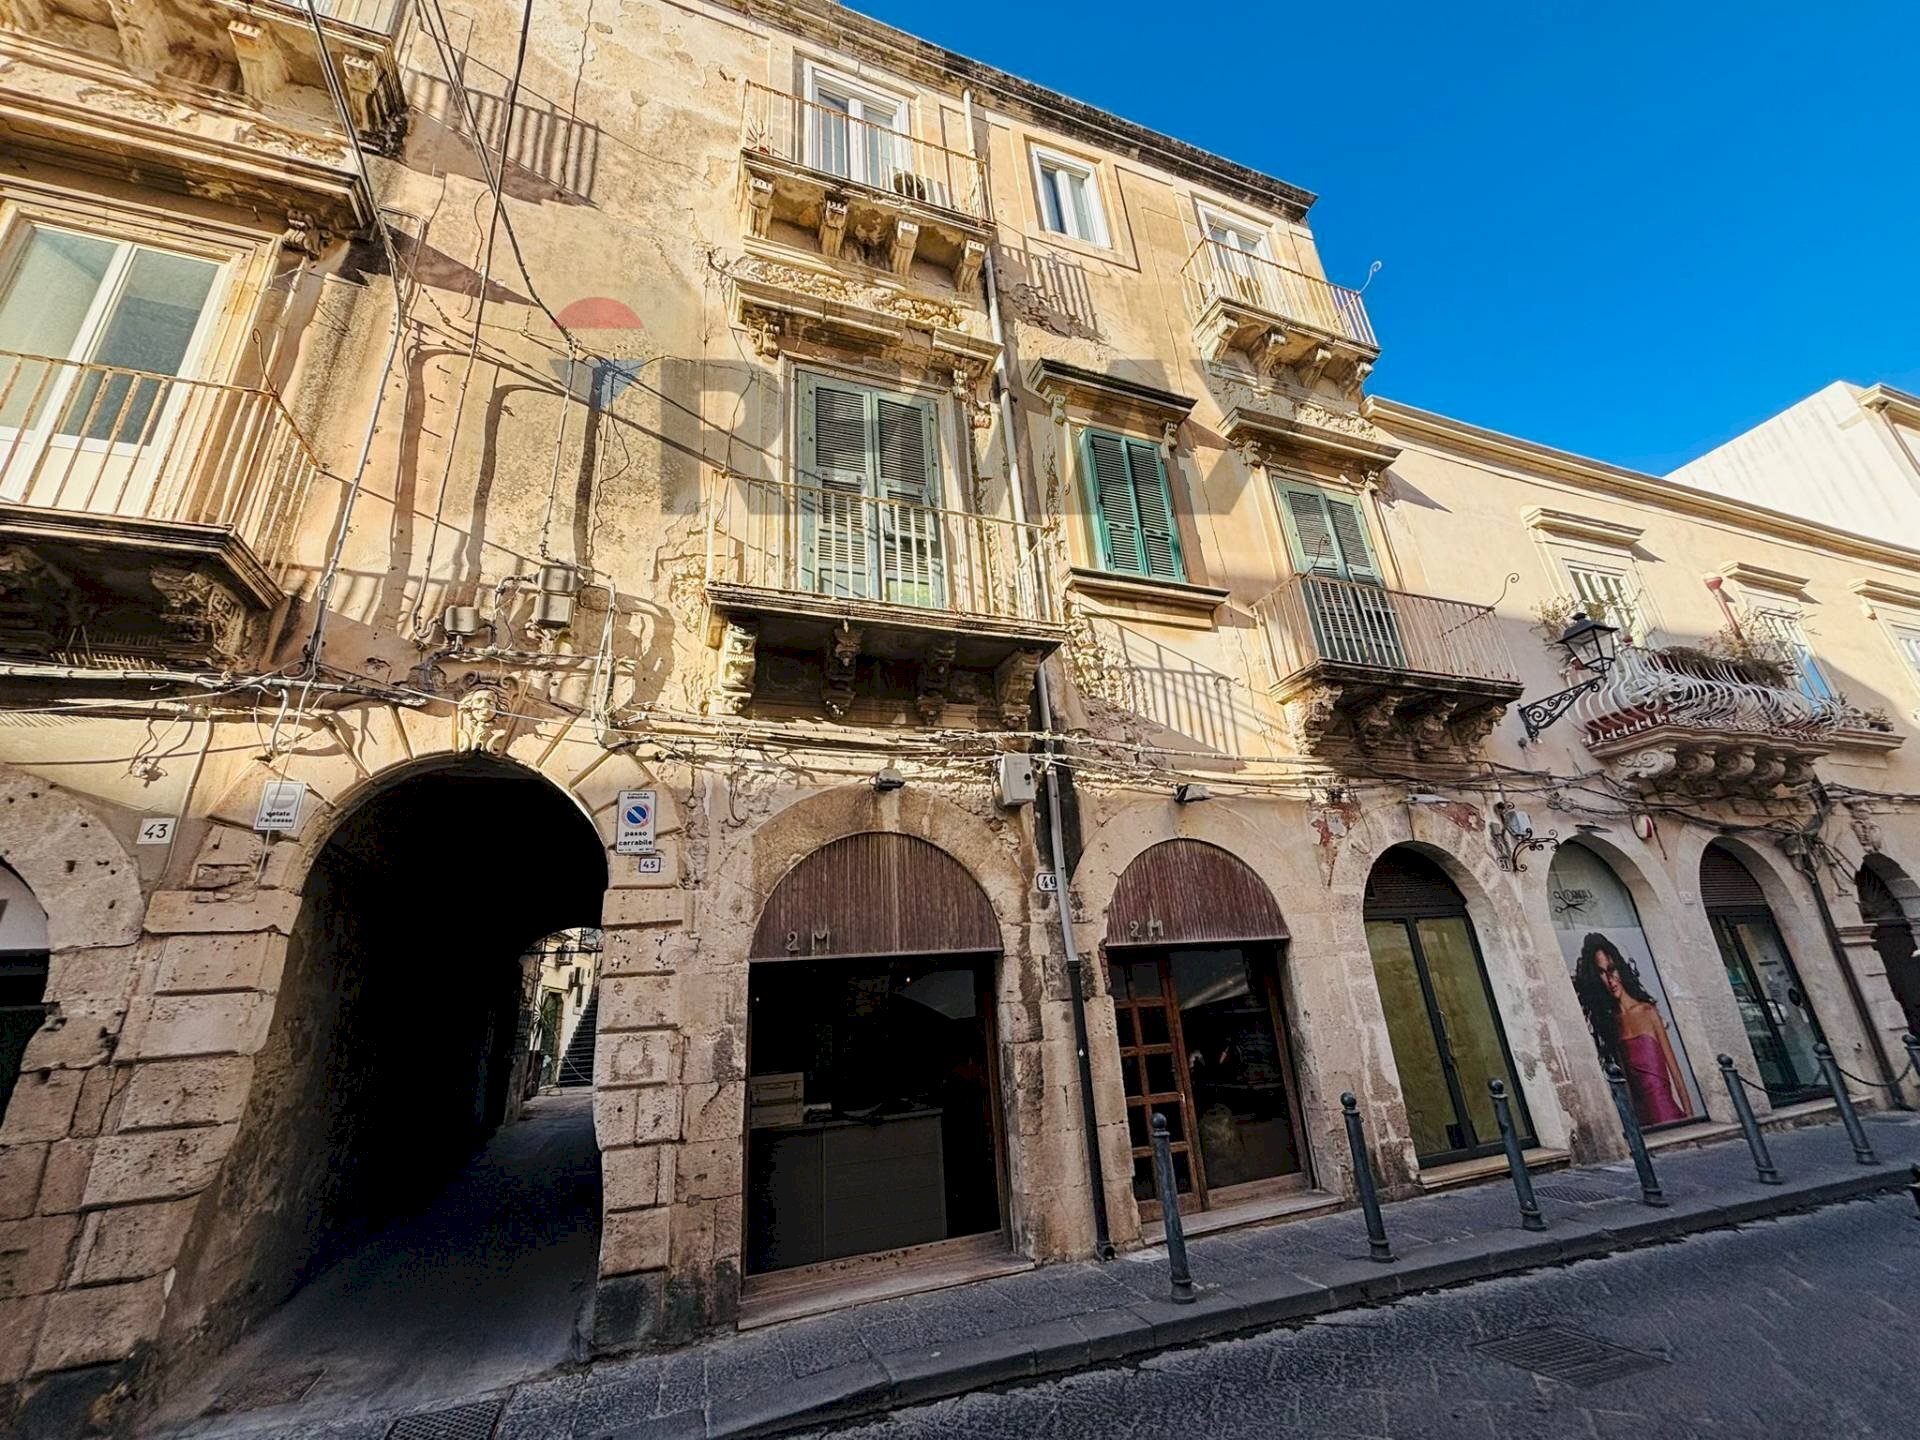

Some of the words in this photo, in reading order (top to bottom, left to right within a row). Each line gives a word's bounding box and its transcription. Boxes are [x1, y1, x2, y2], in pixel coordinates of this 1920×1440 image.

[144, 823, 169, 839] 43
[642, 861, 656, 869] 45
[1040, 875, 1058, 889] 49
